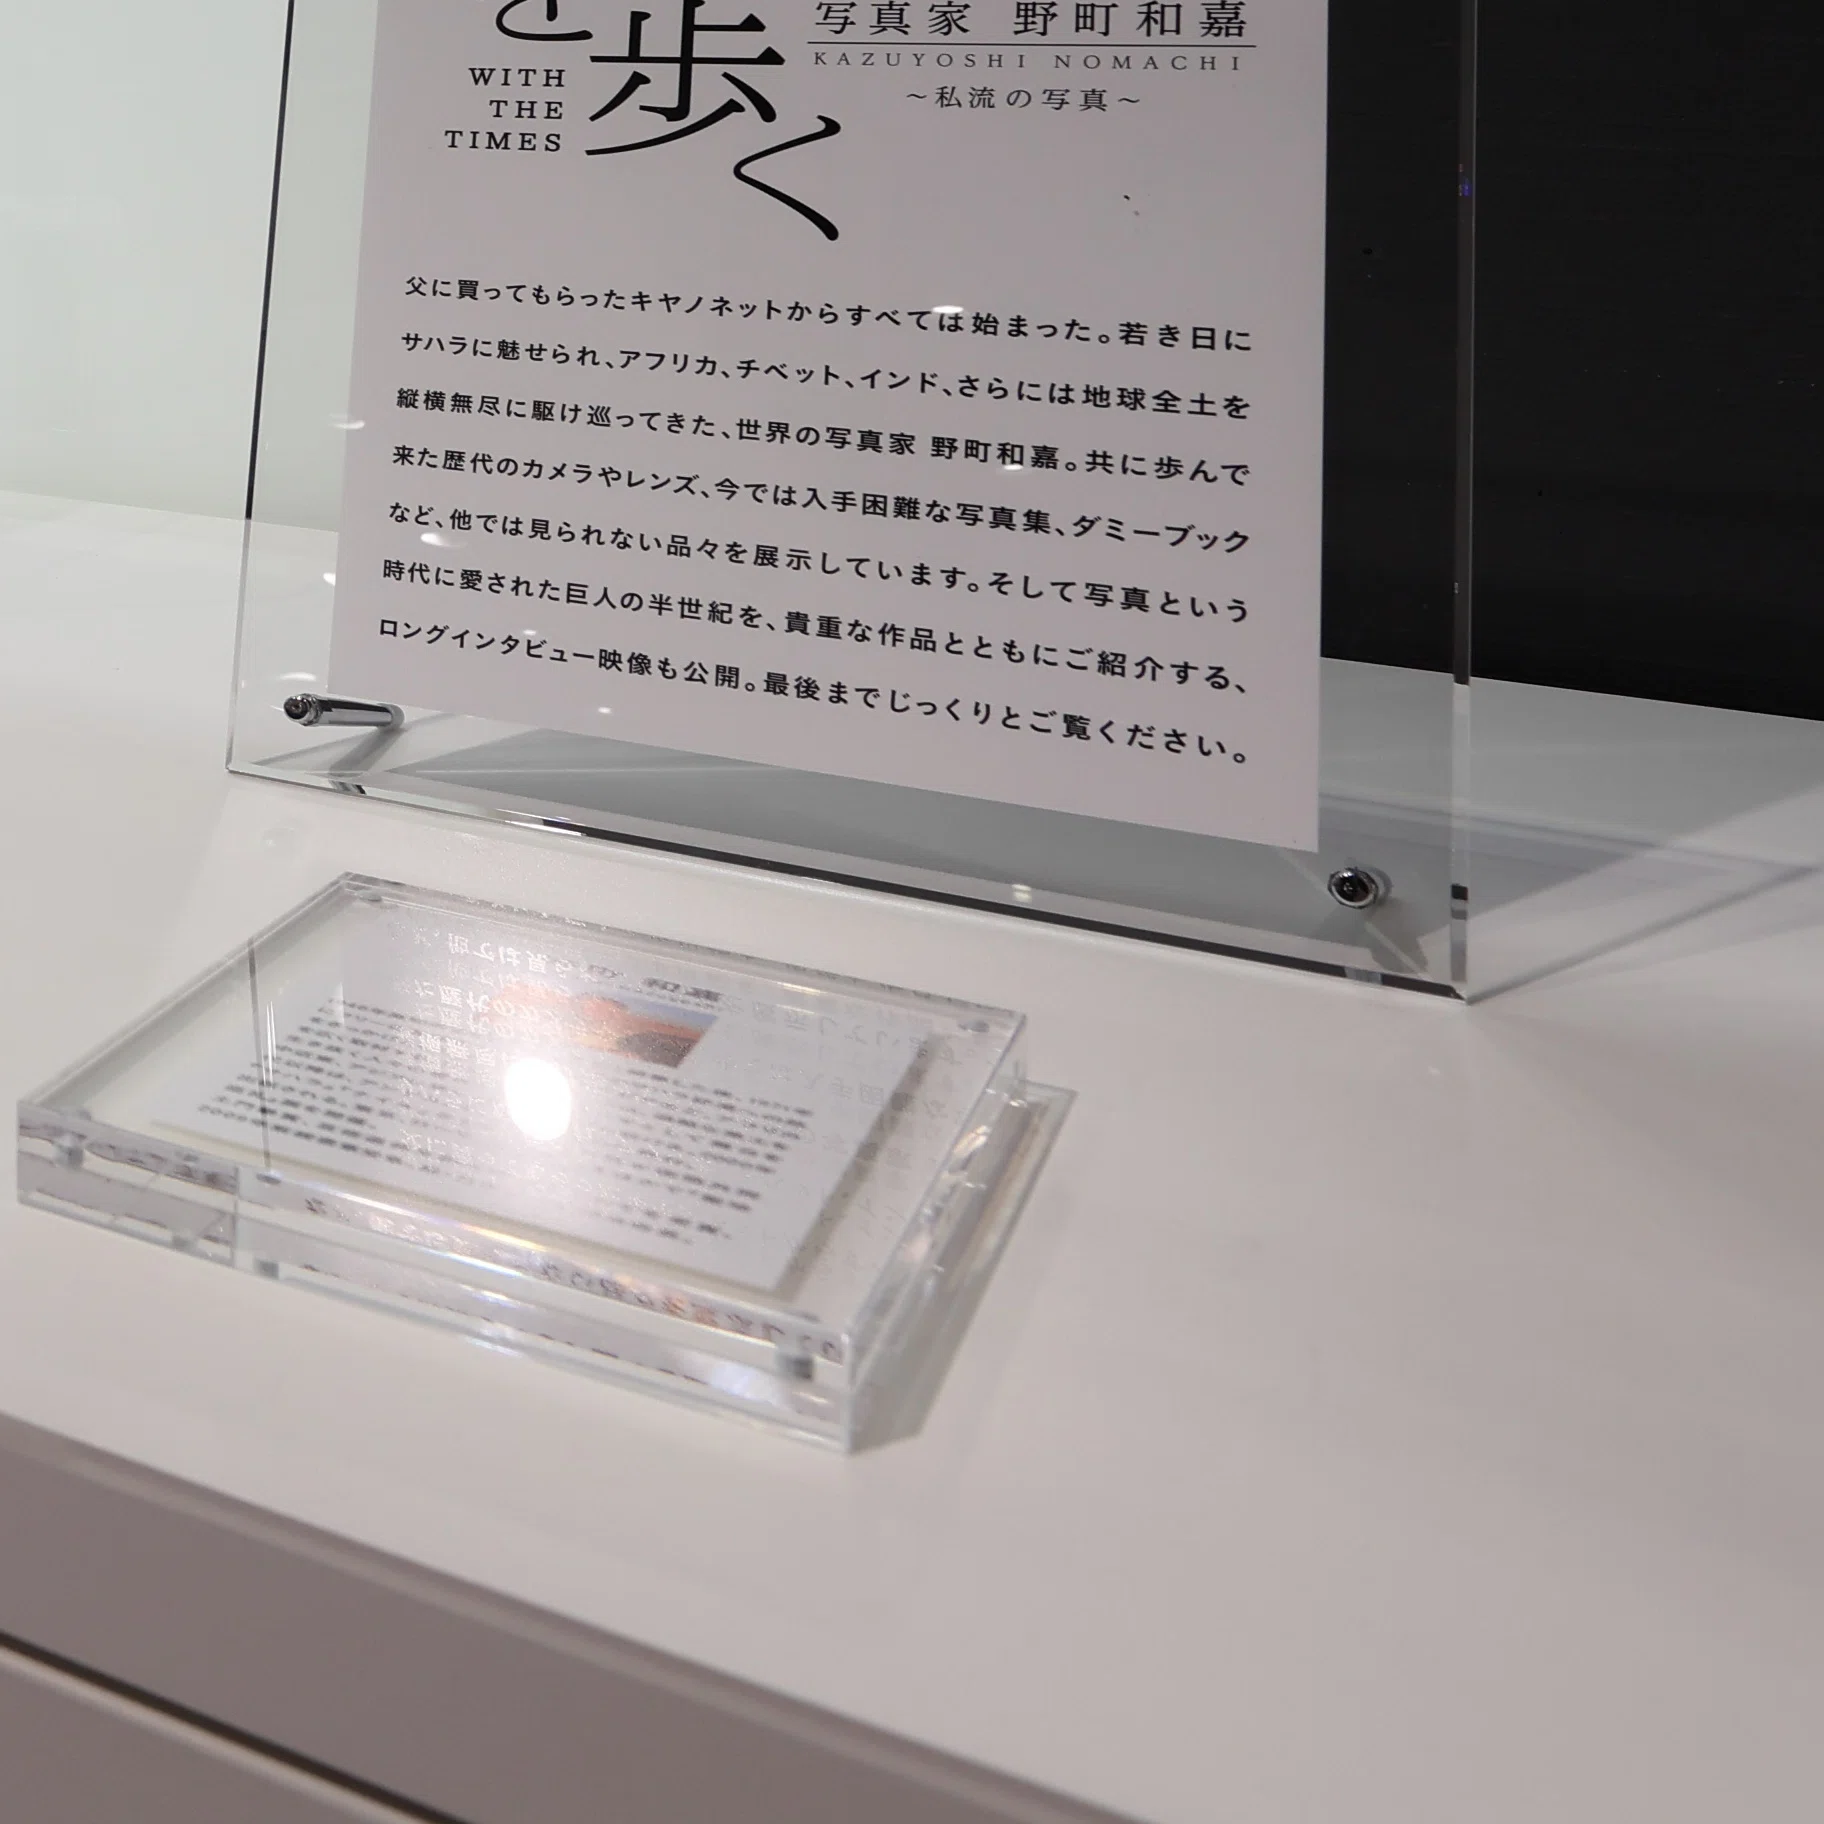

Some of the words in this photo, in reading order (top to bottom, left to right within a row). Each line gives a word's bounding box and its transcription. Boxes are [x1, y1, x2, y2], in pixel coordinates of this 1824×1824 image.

[468, 67, 567, 88] WITH
[813, 51, 1029, 71] KAZUYOSHI
[1053, 53, 1243, 73] NOMACHI
[444, 129, 564, 153] TIMES
[489, 100, 565, 121] THE
[400, 331, 1252, 420] サハラに魅せられ、アフリカ、チベット、インド、さらには地球全土を
[396, 387, 917, 456] 縦横無尽に駆け巡ってきた、世界の写真家
[929, 435, 1251, 487] 野町和嘉。共に歩んで
[392, 443, 1251, 554] 来た歴代のカメラやレンズ、今では入手困難な写真集、ダミーブック
[388, 501, 1249, 623] など、他では見られない品々を展示しています。そして写真という
[383, 558, 1248, 695] 時代に愛された巨人の半世紀を、貴重な作品とともにご紹介する、
[379, 618, 1247, 764] ロングインタビュー映像も公開。最後までじっくりとご覧ください。
